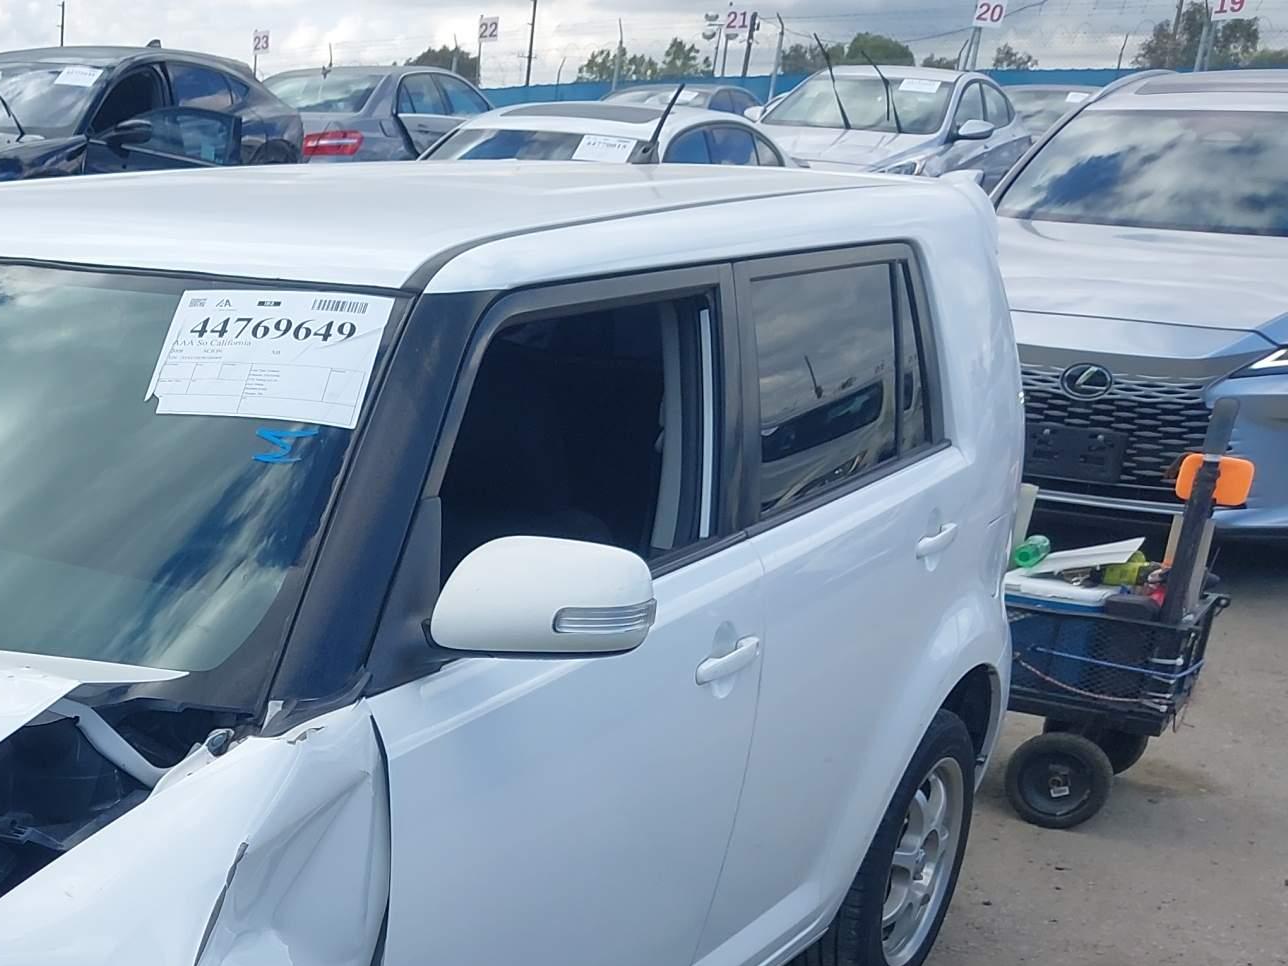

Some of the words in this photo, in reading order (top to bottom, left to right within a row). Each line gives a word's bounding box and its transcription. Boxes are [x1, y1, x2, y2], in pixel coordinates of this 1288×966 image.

[726, 11, 748, 29] 21
[976, 3, 1003, 22] 20
[479, 22, 498, 39] 22
[253, 34, 269, 50] 23
[190, 316, 357, 342] 44769649
[173, 339, 194, 347] AAA
[210, 339, 252, 347] California
